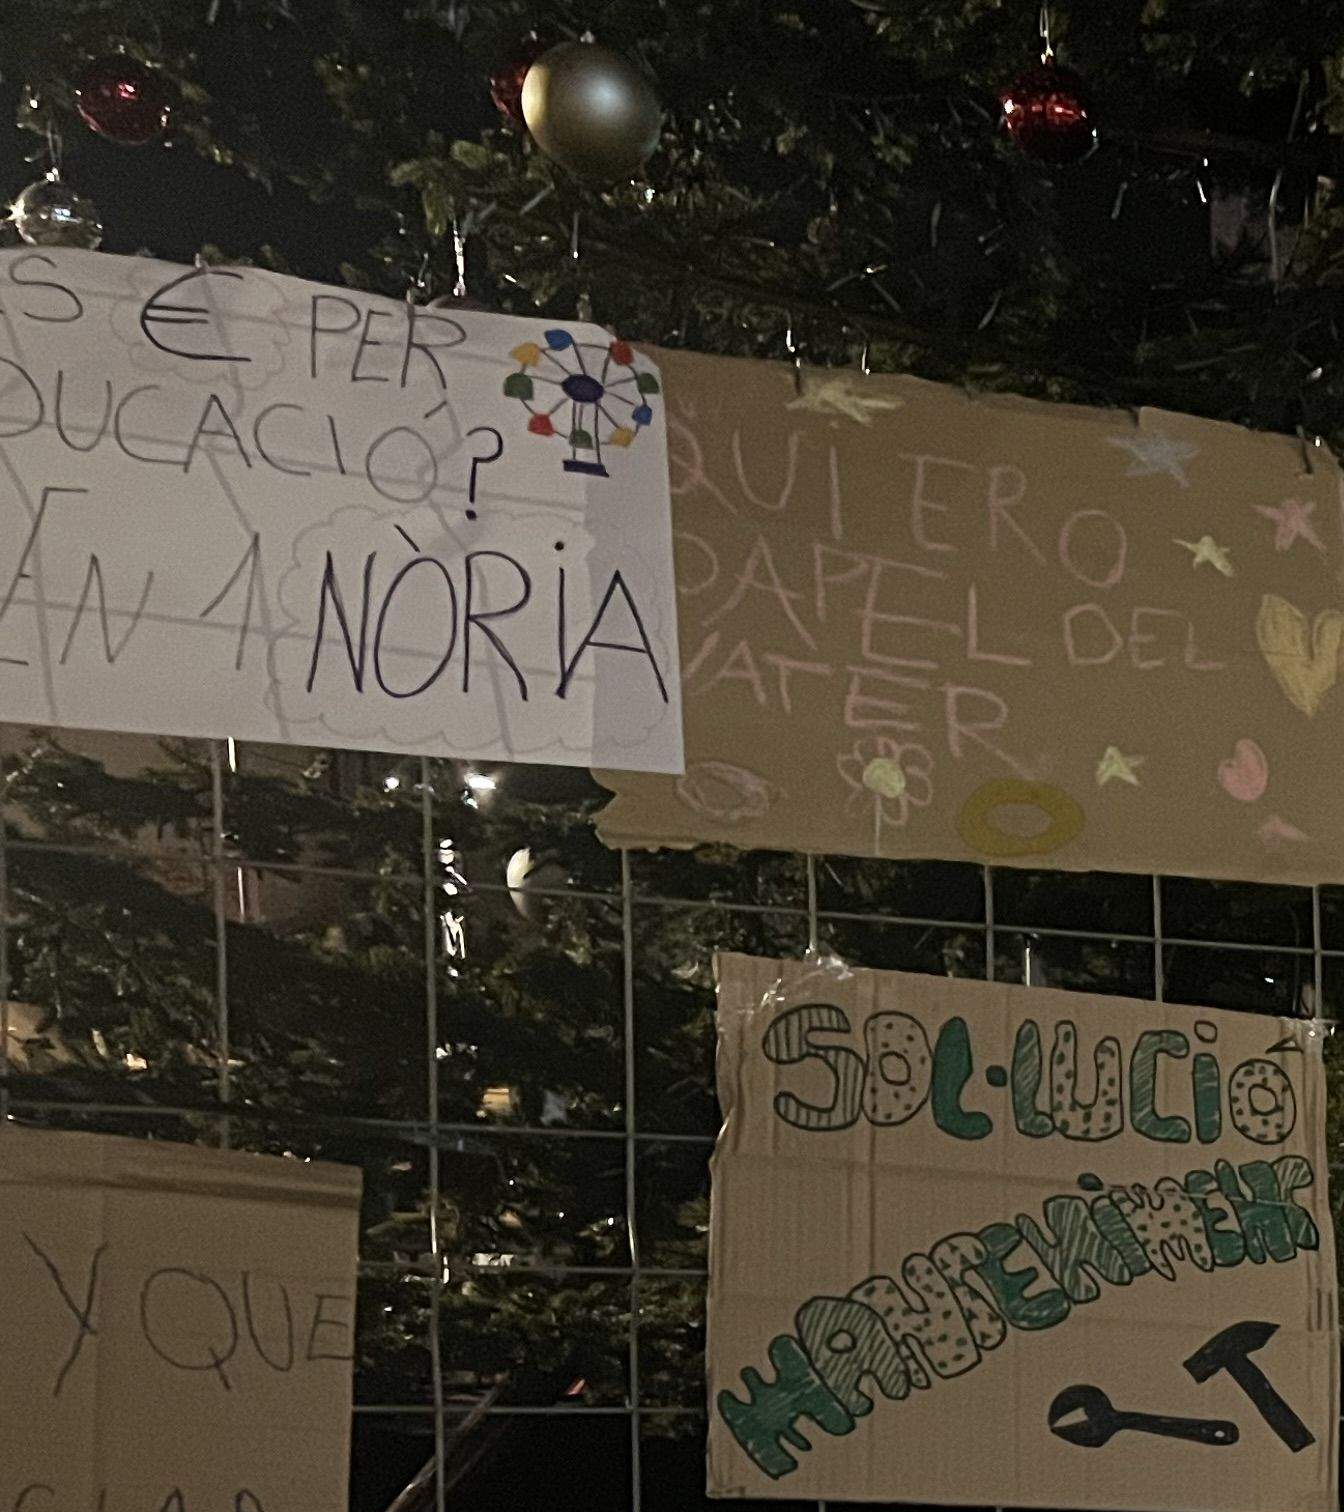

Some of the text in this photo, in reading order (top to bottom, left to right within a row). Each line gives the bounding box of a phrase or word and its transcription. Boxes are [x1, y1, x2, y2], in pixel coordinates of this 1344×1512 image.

[309, 295, 467, 389] PER
[201, 531, 259, 670] 1
[1062, 602, 1226, 671] DEL
[20, 1230, 354, 1399] Y QUE
[715, 1153, 1321, 1480] MANTENIMENT
